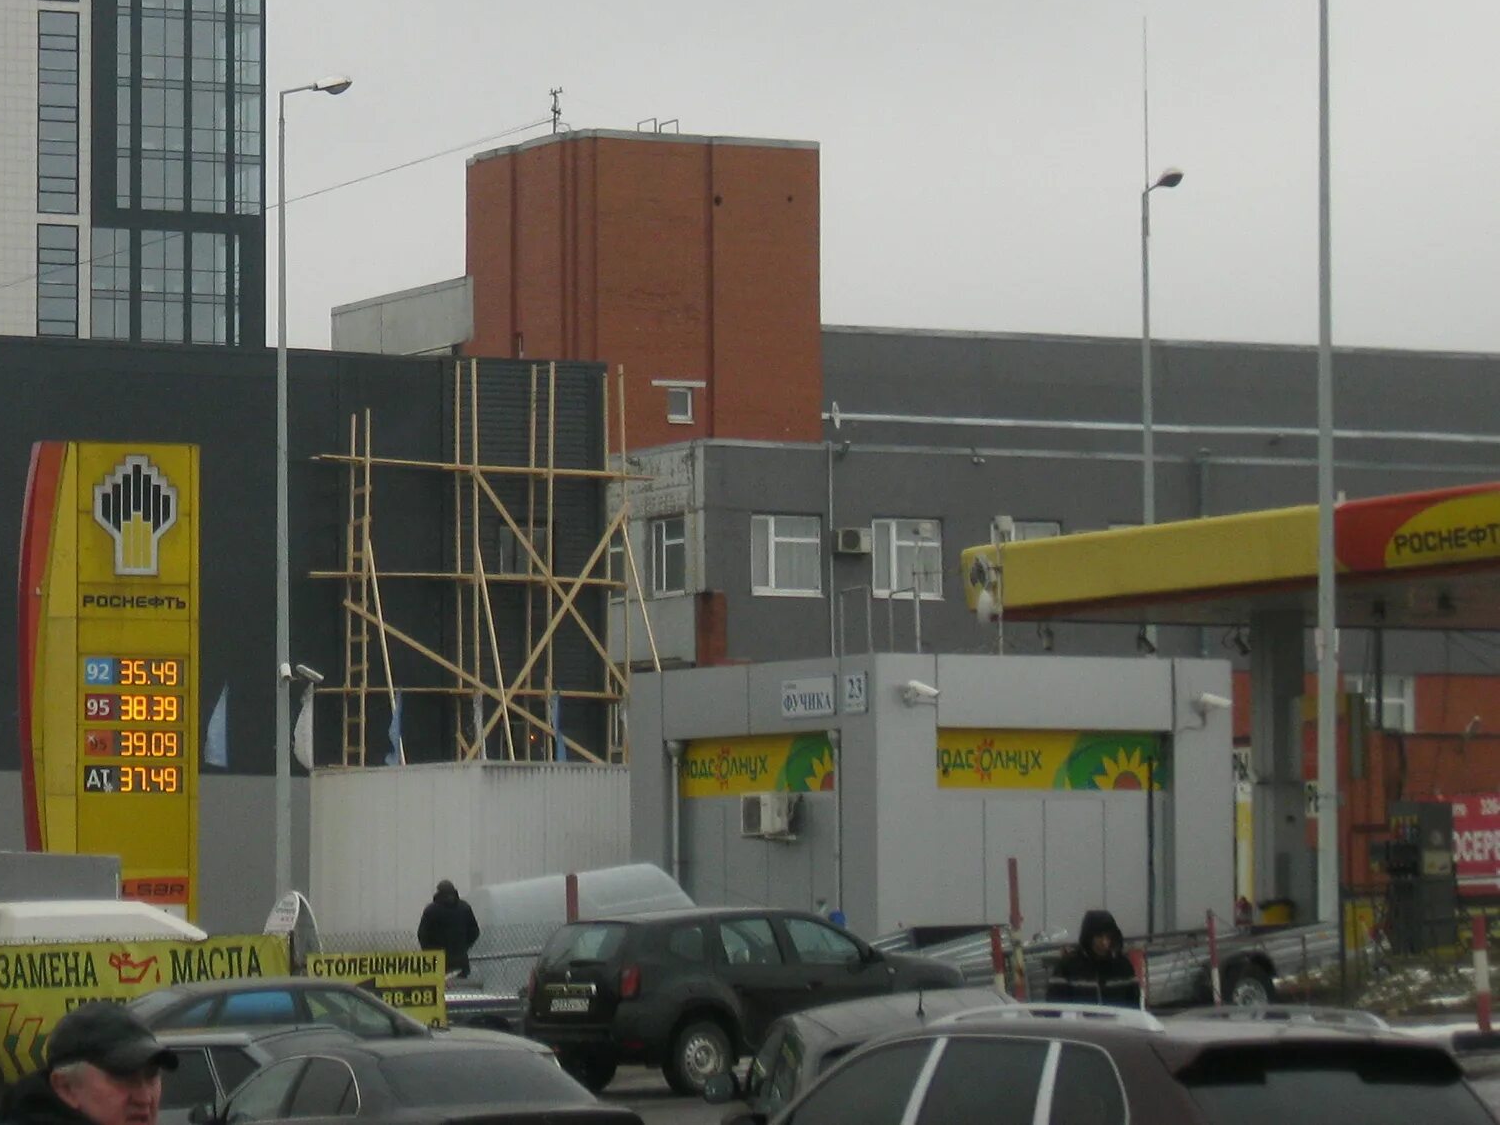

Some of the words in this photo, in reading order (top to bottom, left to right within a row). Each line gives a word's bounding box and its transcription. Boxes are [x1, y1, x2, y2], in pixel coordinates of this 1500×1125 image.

[82, 594, 187, 610] РОСНЕФТЬ
[87, 663, 110, 681] 92
[120, 659, 178, 686] 35.49
[783, 691, 833, 712] ФУЧИКА
[848, 677, 863, 700] 23
[87, 698, 110, 716] 95
[120, 695, 178, 721] 38.39
[120, 731, 178, 757] 39.09
[120, 767, 178, 793] 37.49
[169, 945, 263, 986] МАСЛА
[312, 955, 438, 977] СТОЛЕШНИЦЫ
